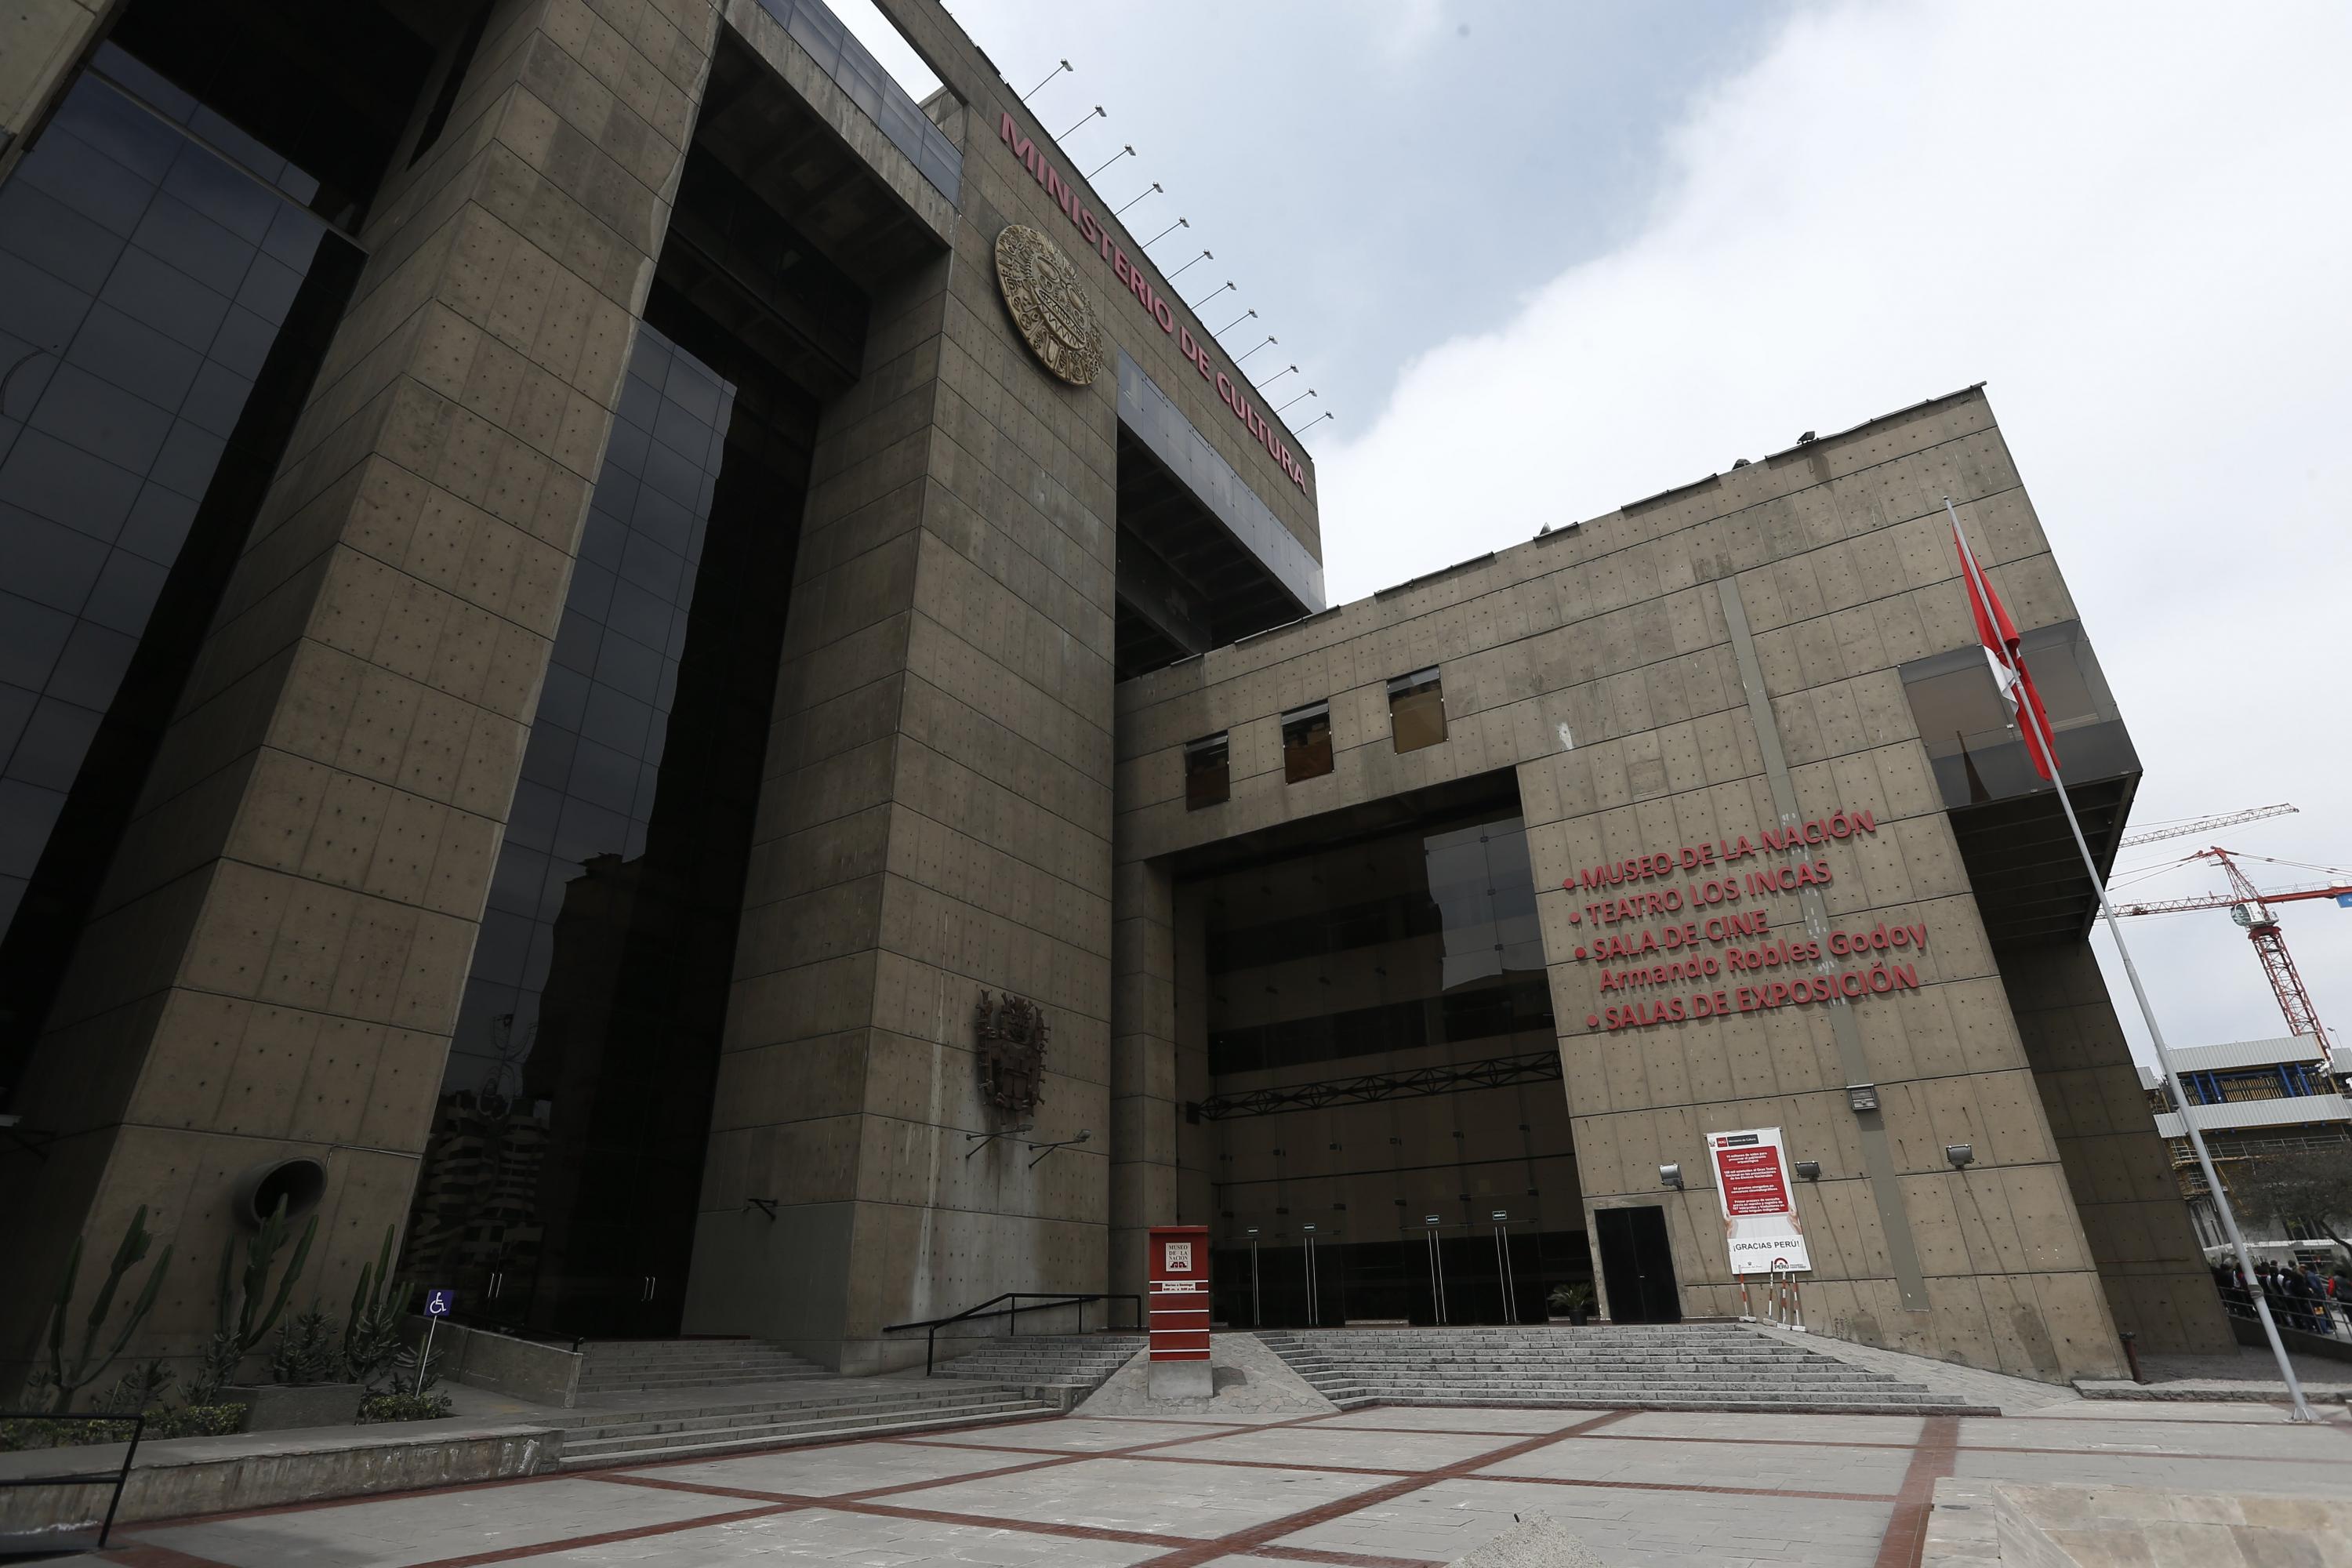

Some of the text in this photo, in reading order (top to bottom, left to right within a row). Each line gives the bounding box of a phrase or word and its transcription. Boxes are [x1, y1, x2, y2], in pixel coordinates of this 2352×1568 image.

[1000, 112, 1308, 495] MINISTERIO DE CULTURA
[1580, 809, 1876, 891] MUSEO DE LA NACIÓN
[1586, 859, 1832, 925] TEATRO LOS INCAS
[1592, 909, 1769, 960] SALA DE CINE
[1599, 922, 1926, 992] Armando Robles Godoy
[1605, 961, 1919, 1029] SALAS DE EXPOSICIÓN
[1733, 1240, 1801, 1252] ¡GRACIAS PERÚ!
